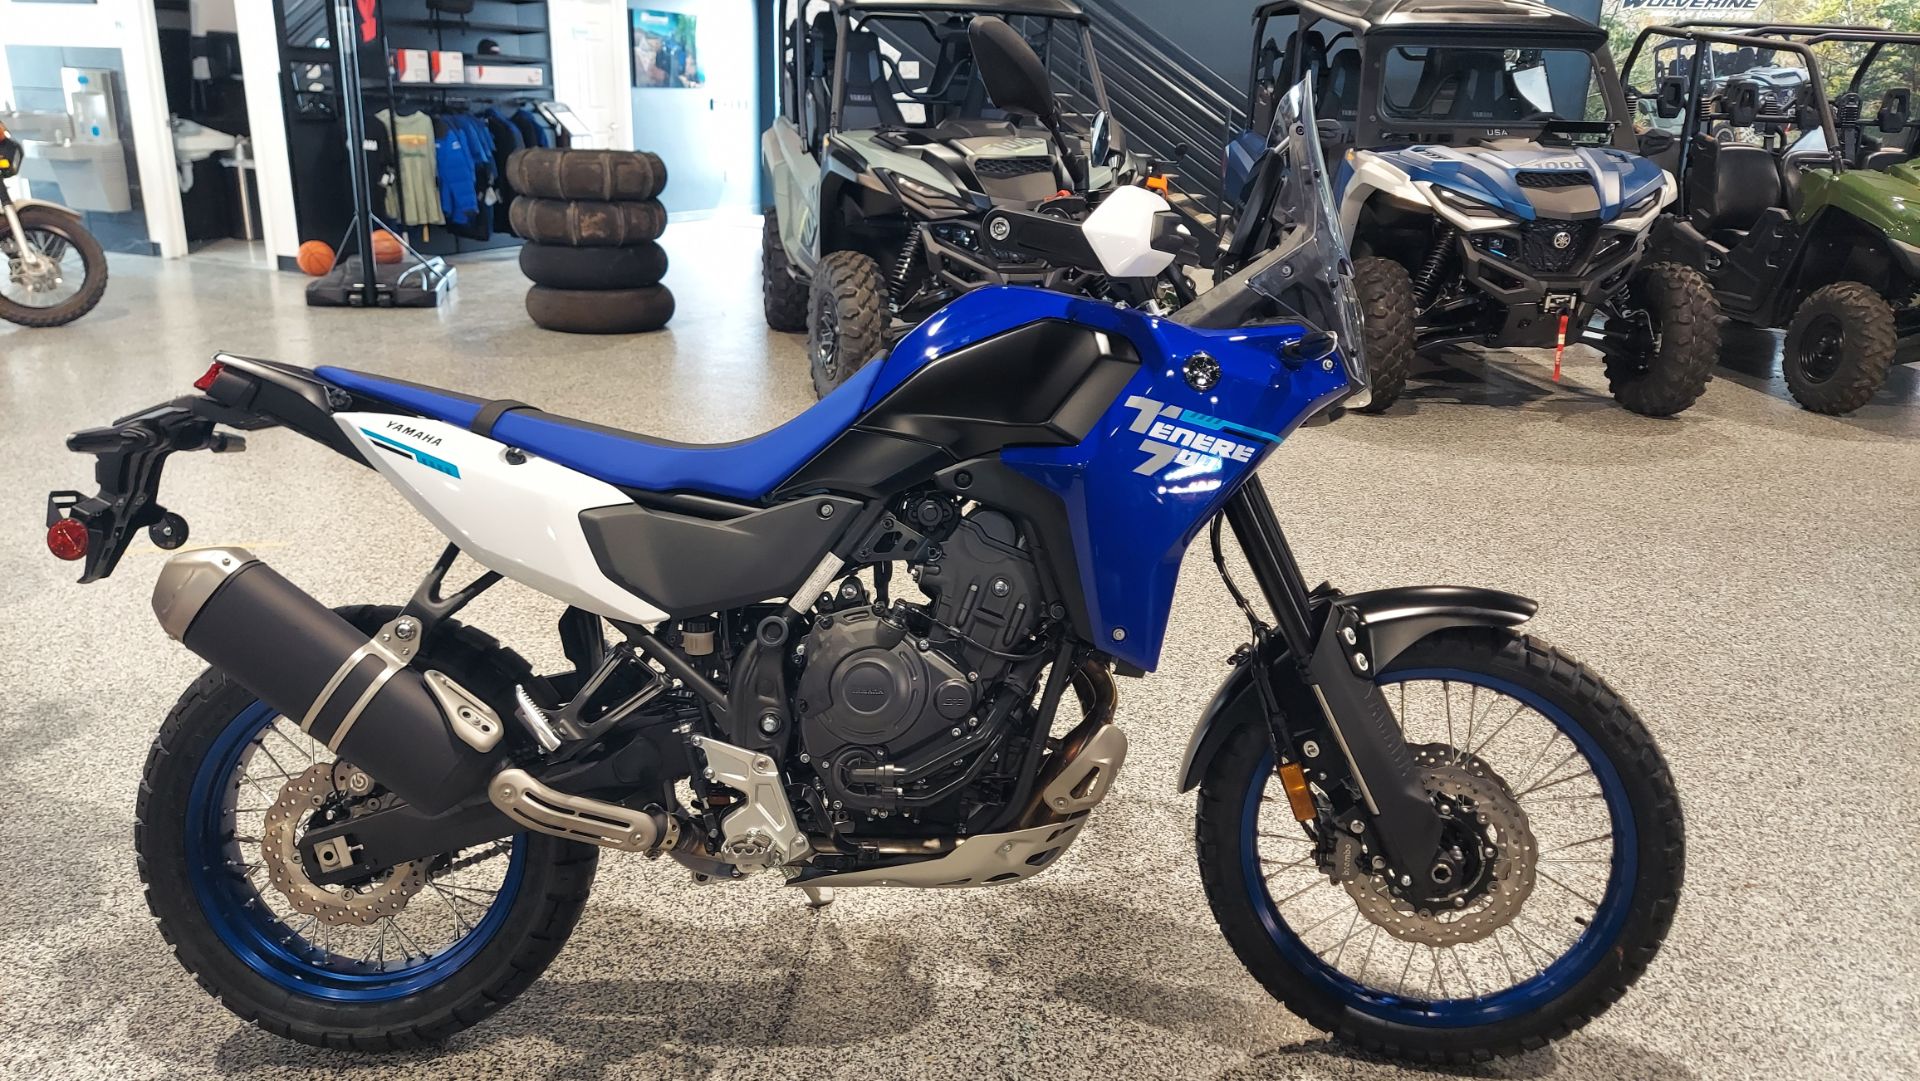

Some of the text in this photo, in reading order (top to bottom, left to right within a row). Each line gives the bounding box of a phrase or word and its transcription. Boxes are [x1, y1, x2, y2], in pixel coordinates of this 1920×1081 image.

[386, 420, 443, 447] YAMAHA
[1132, 438, 1223, 476] 700
[1342, 843, 1352, 876] brembo
